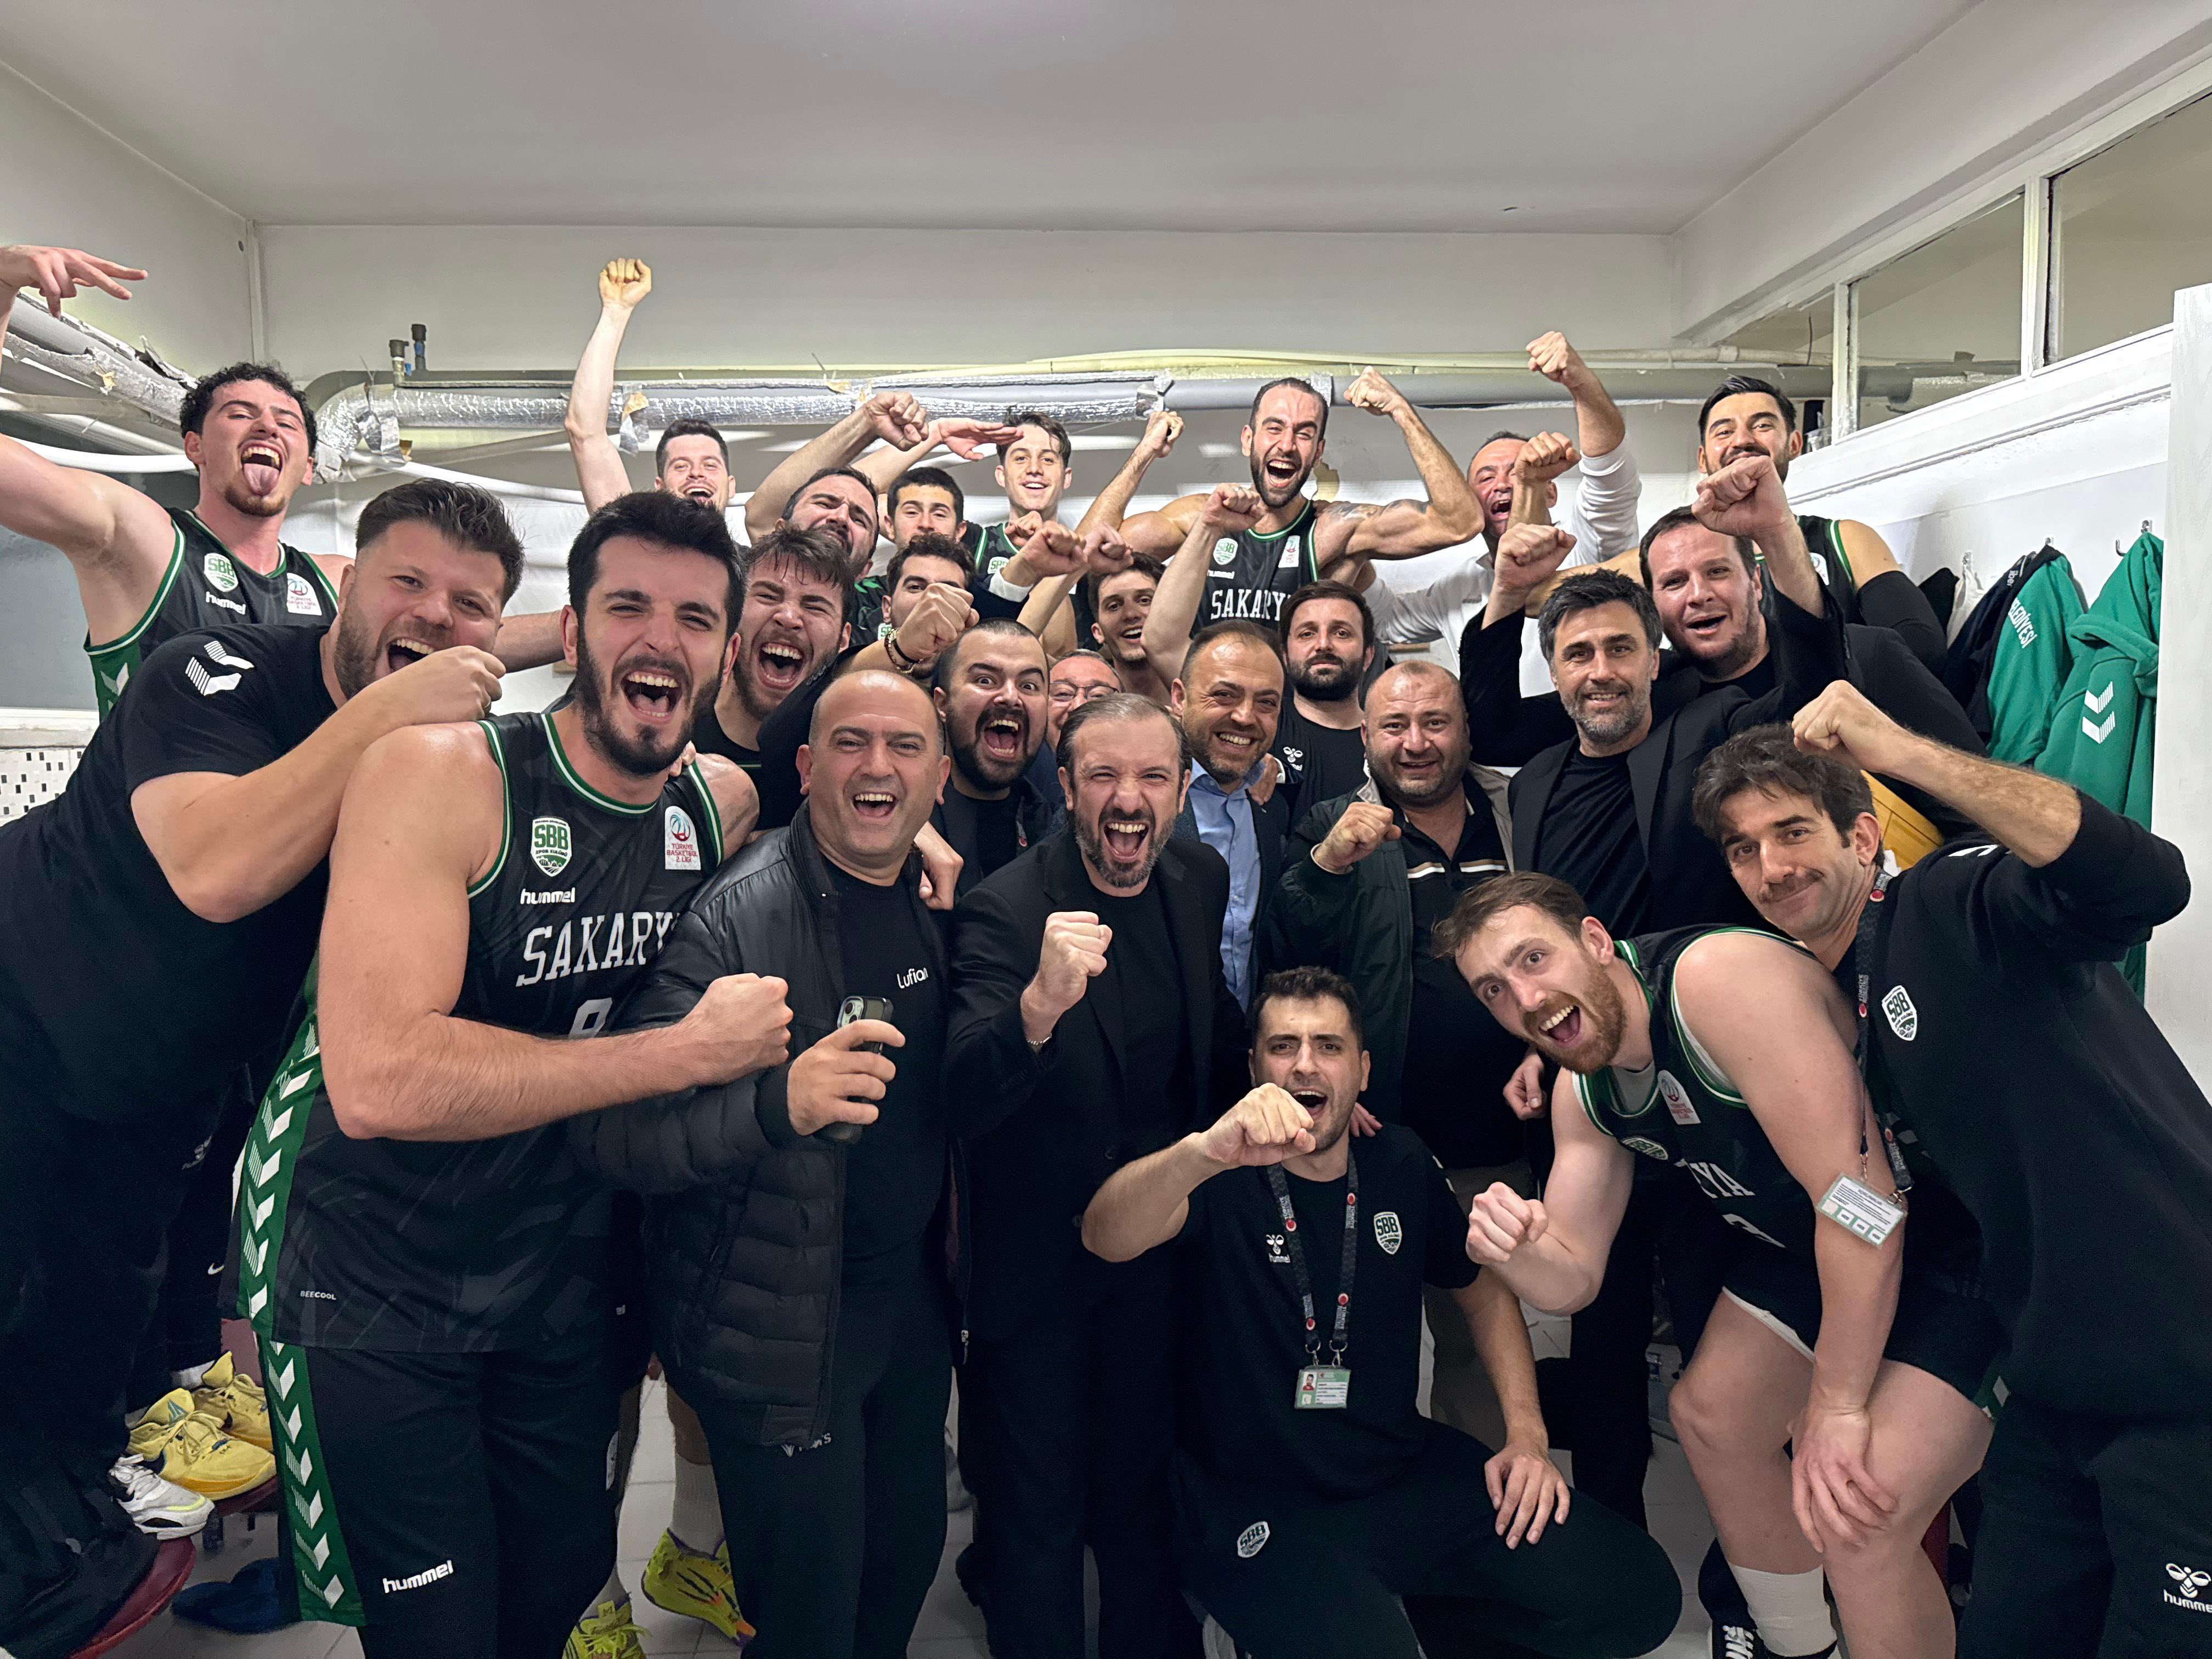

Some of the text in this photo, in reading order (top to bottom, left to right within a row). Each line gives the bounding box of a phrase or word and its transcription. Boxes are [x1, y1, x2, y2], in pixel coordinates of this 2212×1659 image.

[206, 591, 246, 615] hummel
[1211, 589, 1291, 621] SAKARY
[534, 825, 568, 850] SBB
[520, 887, 575, 905] hummel
[516, 911, 680, 988] SAKARY
[1886, 991, 1911, 1023] SBB
[1375, 1216, 1399, 1237] SBB
[300, 1290, 337, 1301] BEECOOL
[1240, 1525, 1266, 1547] SBB
[382, 1560, 454, 1594] hummel
